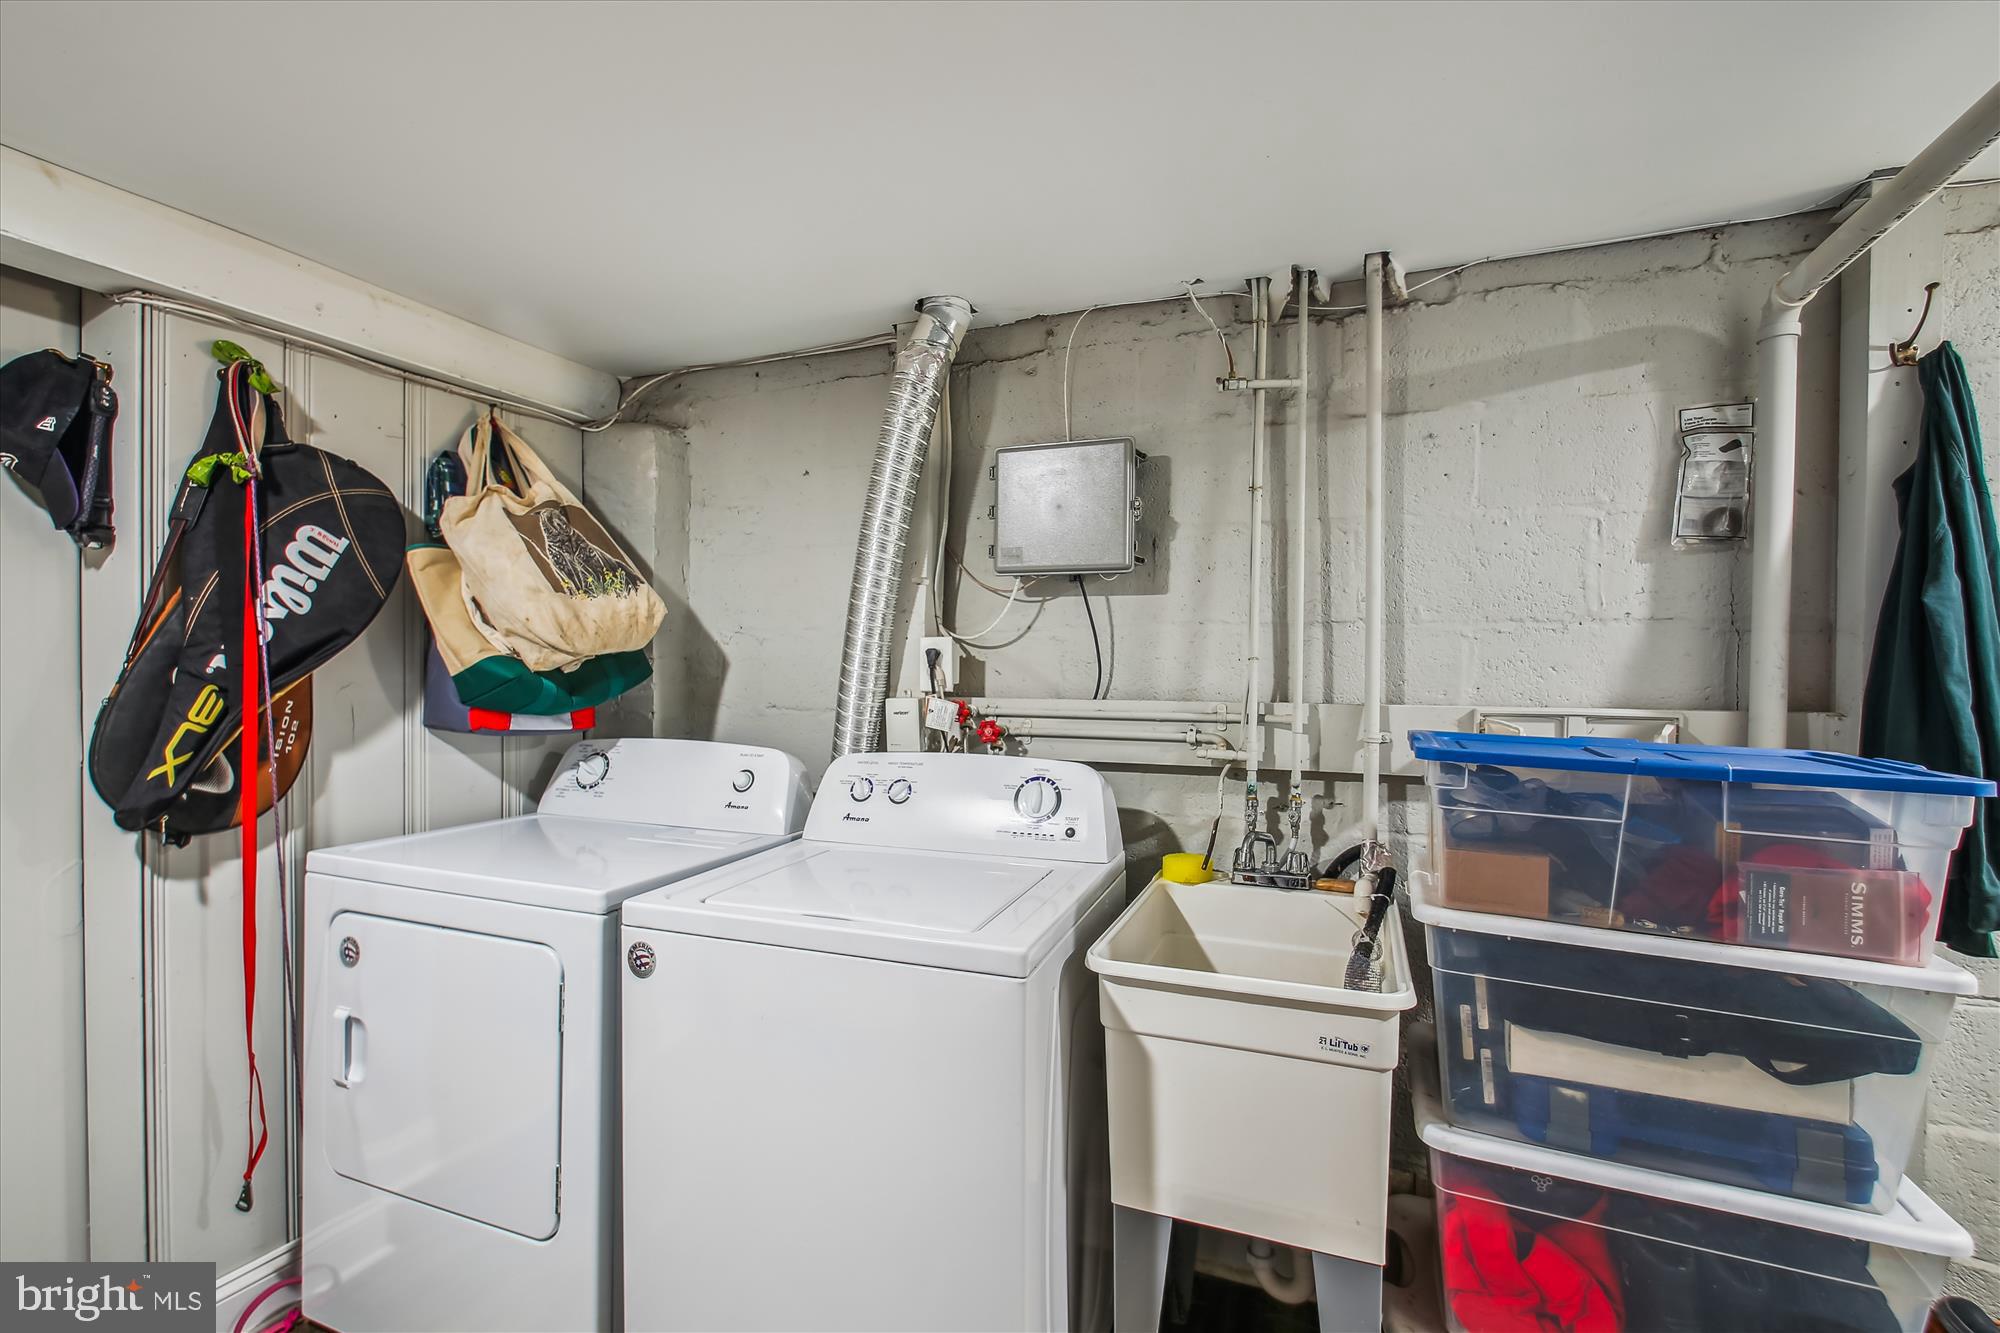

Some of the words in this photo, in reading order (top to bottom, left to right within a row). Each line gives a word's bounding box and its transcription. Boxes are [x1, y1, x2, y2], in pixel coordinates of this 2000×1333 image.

[284, 720, 300, 753] 102
[724, 801, 749, 810] Amana
[842, 813, 870, 823] Amana
[1851, 882, 1867, 945] SIMMS
